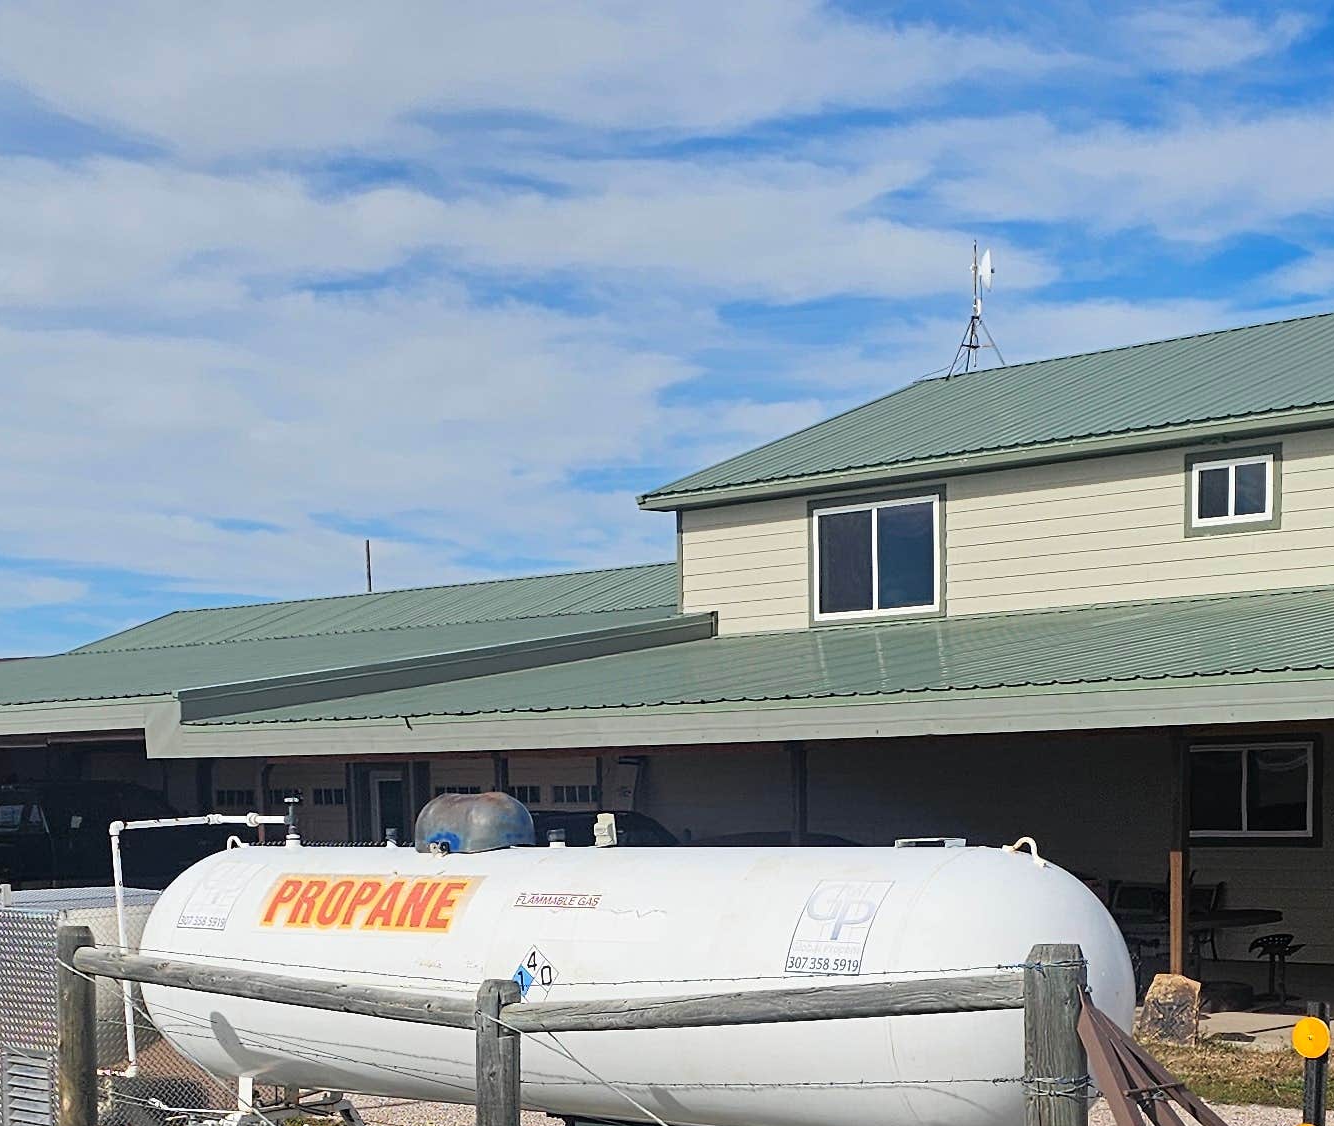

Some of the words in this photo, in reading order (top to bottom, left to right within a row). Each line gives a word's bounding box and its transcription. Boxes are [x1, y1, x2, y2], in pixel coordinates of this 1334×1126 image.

[262, 880, 468, 929] PROPANE
[515, 896, 577, 906] FLAMMABLE
[577, 897, 600, 907] GAS
[527, 951, 537, 971] 4
[788, 957, 808, 969] 307
[809, 958, 830, 970] 358
[832, 959, 859, 972] 5919
[518, 971, 525, 991] 1
[541, 965, 552, 986] 0
